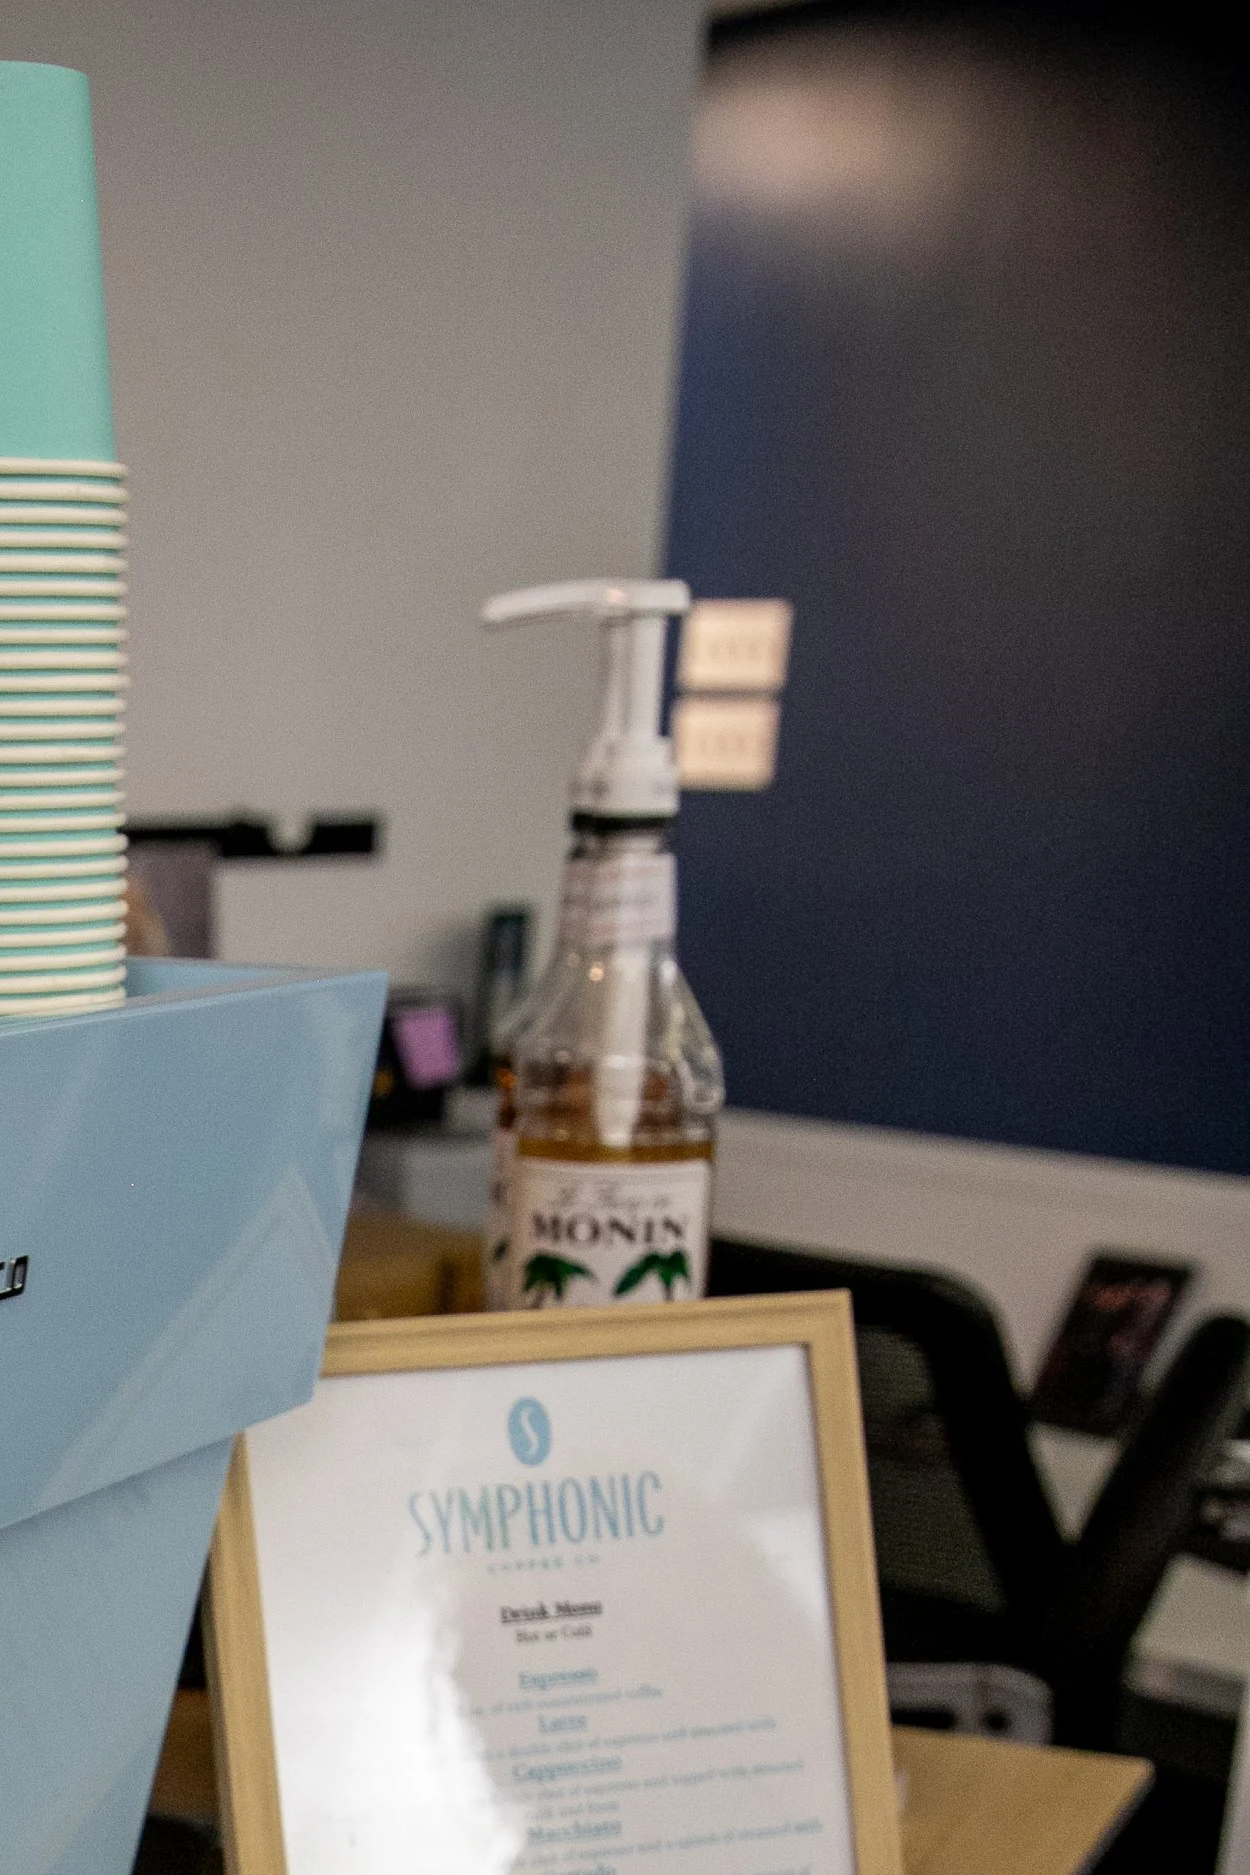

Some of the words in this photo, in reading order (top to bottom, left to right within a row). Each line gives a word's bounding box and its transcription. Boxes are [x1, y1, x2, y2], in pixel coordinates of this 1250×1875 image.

[530, 1210, 688, 1246] MONIN
[408, 1469, 665, 1560] SYMPHONIC
[500, 1601, 549, 1625] Drink
[554, 1600, 603, 1618] Menu
[518, 1668, 598, 1691] Espresso
[538, 1714, 587, 1734] Latte
